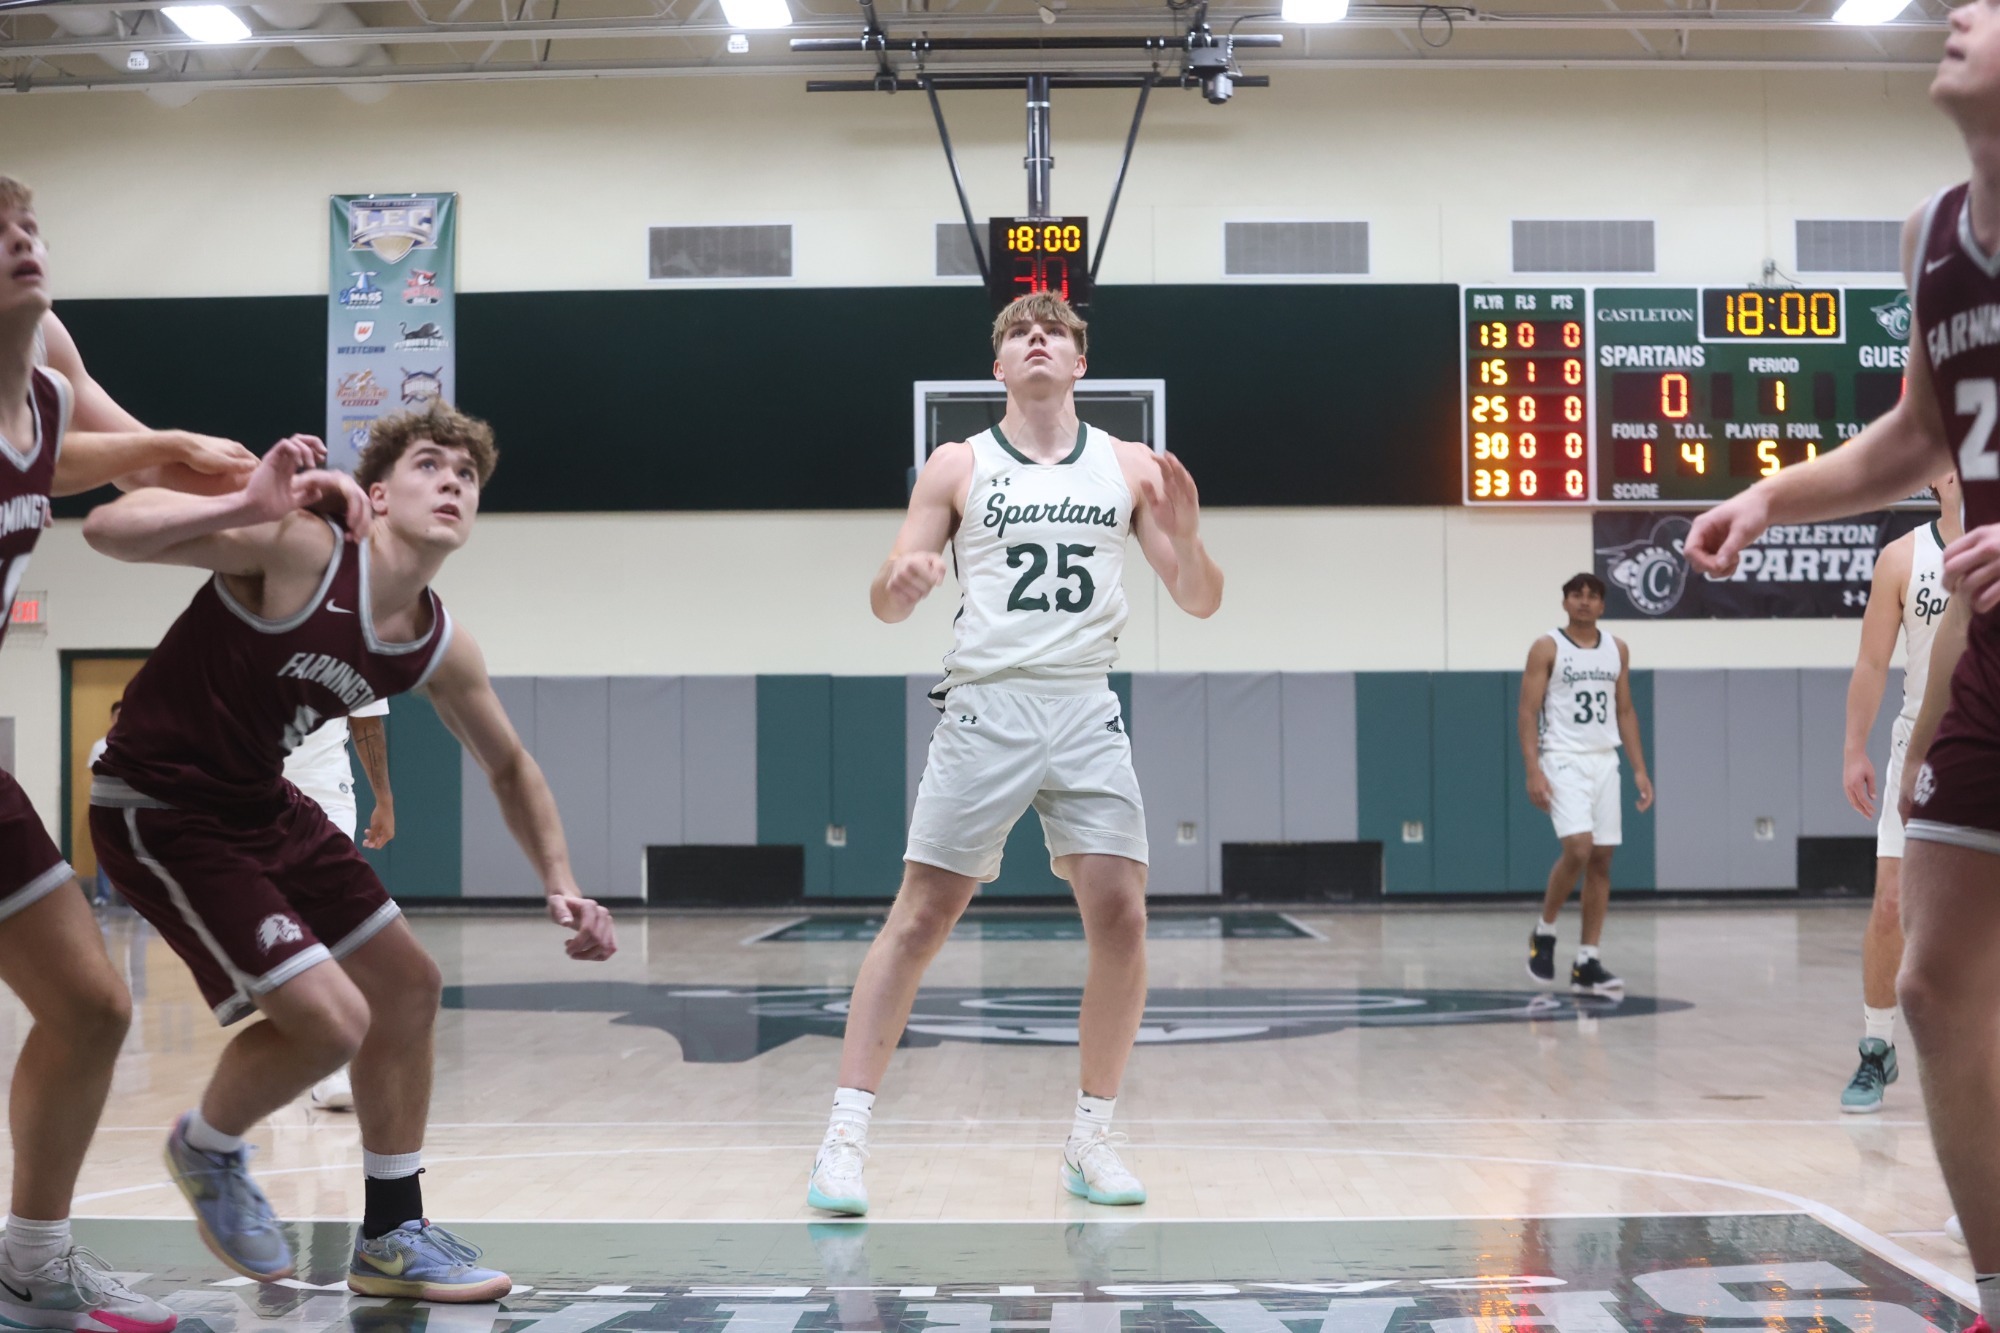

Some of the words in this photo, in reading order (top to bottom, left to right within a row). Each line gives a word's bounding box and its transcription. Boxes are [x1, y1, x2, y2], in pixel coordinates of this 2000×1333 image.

[1008, 225, 1081, 252] 18:00
[1473, 294, 1504, 310] PLYR
[1515, 294, 1537, 310] FLS
[1551, 294, 1574, 310] PTS
[1597, 308, 1694, 322] CASTLETON
[1726, 292, 1836, 335] 18:00
[1480, 322, 1507, 348] 13
[1518, 322, 1535, 348] 0
[1564, 322, 1581, 348] 0
[1600, 345, 1706, 367] SPARTANS
[1748, 357, 1800, 373] PERIOD
[1481, 359, 1508, 386] 15
[1528, 361, 1536, 383] 1
[1564, 359, 1581, 385] 0
[1472, 395, 1509, 423] 25
[1519, 395, 1536, 422] 0
[1565, 395, 1582, 422] 0
[1661, 373, 1689, 418] 0
[1775, 380, 1785, 411] 1
[1611, 423, 1658, 439] FOULS
[1673, 423, 1713, 439] T.O.L.
[1725, 423, 1779, 439] PLAYER
[1787, 423, 1823, 439] FOUL
[1475, 432, 1510, 460] 30
[1519, 432, 1537, 459] 0
[1565, 432, 1583, 459] 0
[1643, 443, 1652, 474] 1
[1681, 443, 1705, 474] 4
[1757, 440, 1780, 477] 5
[1475, 469, 1510, 497] 33
[1520, 469, 1537, 496] 0
[1566, 469, 1583, 496] 0
[1612, 483, 1659, 499] SCORE
[983, 492, 1118, 538] Spartans
[1005, 542, 1097, 614] 25
[1574, 691, 1608, 724] 33
